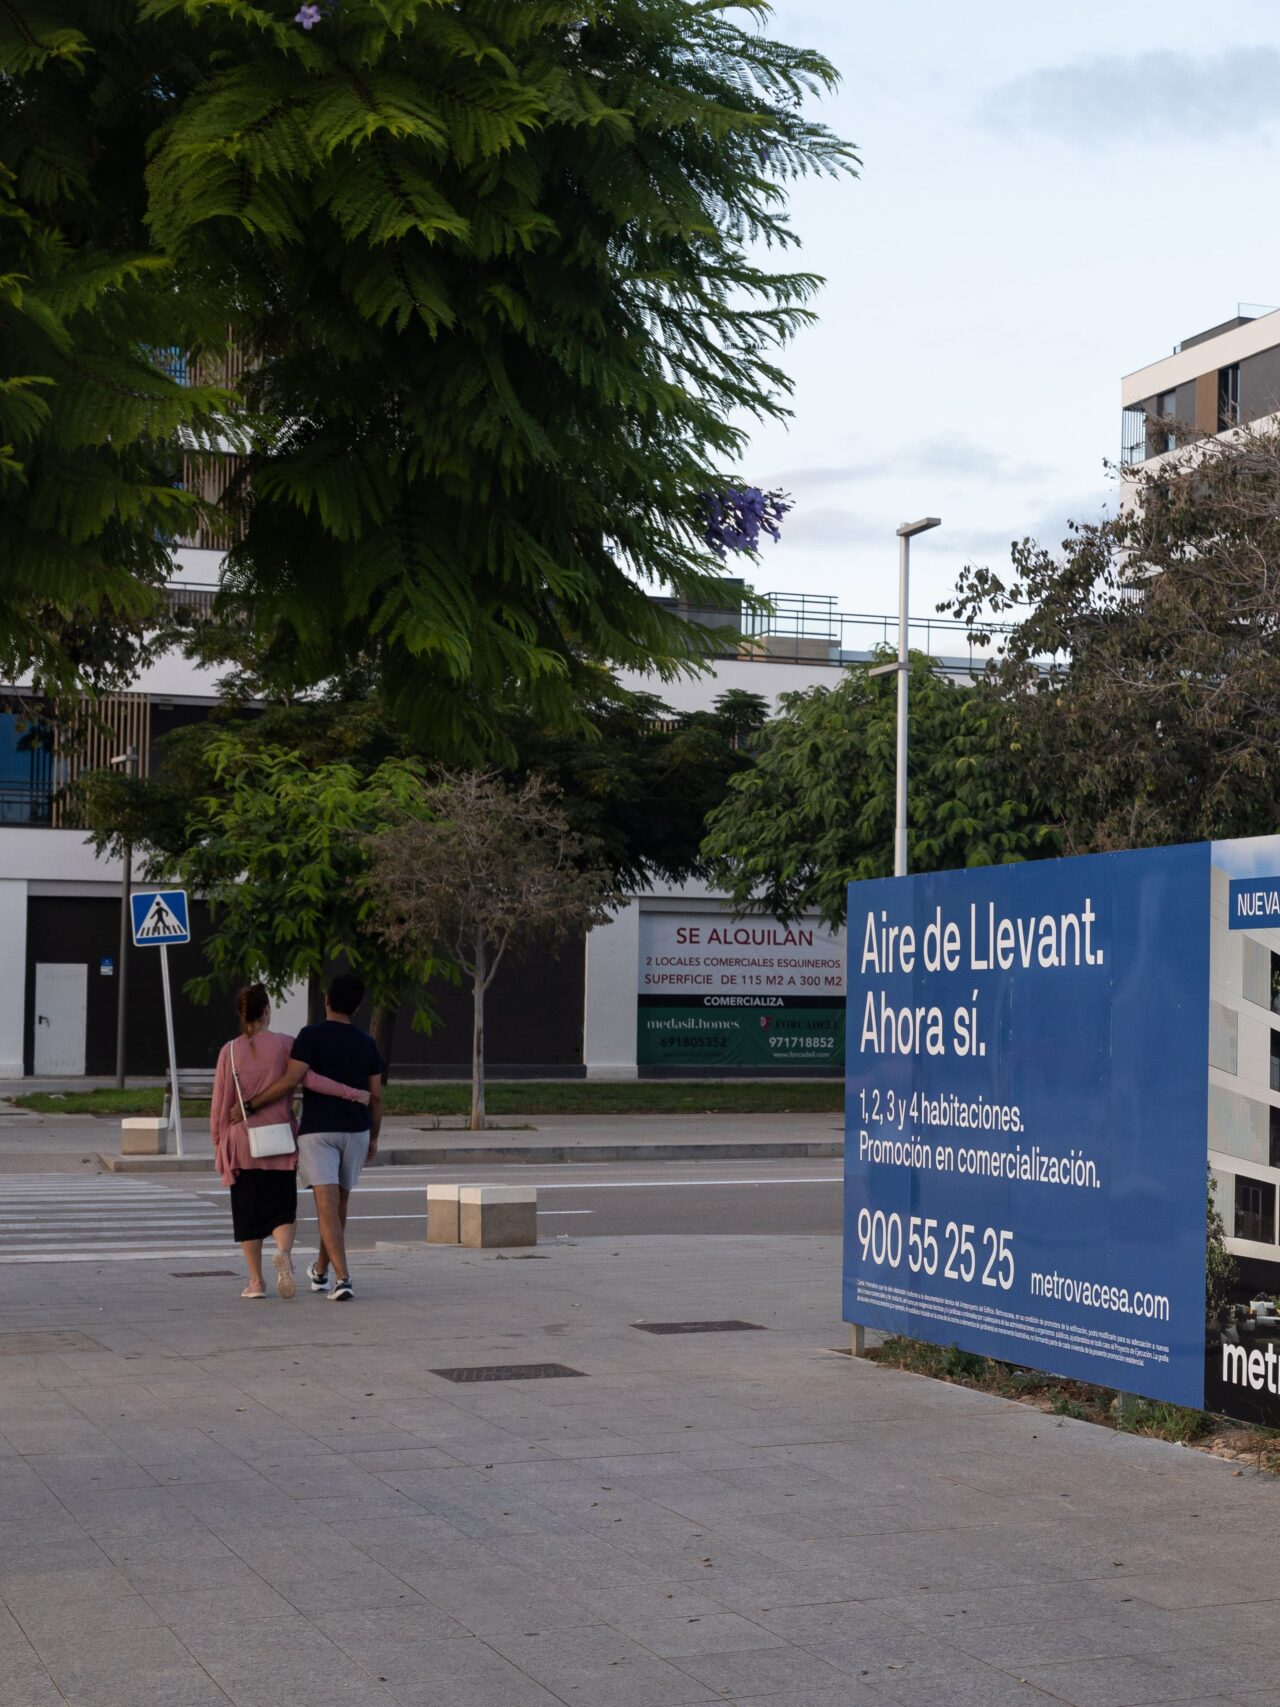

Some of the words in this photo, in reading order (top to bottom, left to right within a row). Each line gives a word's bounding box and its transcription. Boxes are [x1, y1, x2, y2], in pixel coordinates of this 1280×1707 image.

[1237, 890, 1280, 916] NUEVA
[676, 927, 700, 945] SE
[707, 928, 813, 946] ALQUILAN
[860, 910, 916, 974] Aire
[923, 905, 961, 973] de
[970, 898, 1104, 970] Llevant.
[645, 956, 653, 967] 2
[655, 956, 701, 967] LOCALES
[703, 957, 775, 968] COMERCIALES
[777, 958, 841, 969] ESQUINEROS
[644, 974, 713, 985] SUPERFICIE
[720, 974, 737, 985] DE
[741, 975, 762, 985] 115
[766, 975, 784, 986] M2
[787, 975, 796, 986] A
[800, 975, 821, 986] 300
[824, 976, 842, 986] M2
[703, 996, 785, 1007] COMERCIALIZA
[647, 1017, 740, 1030] medasil.homes
[860, 990, 945, 1056] Ahora
[953, 988, 986, 1057] sí.
[769, 1037, 835, 1048] 971718852
[859, 1088, 869, 1124] 1,
[871, 1088, 883, 1125] 2,
[886, 1089, 895, 1122] 3
[897, 1098, 907, 1131] y
[909, 1091, 919, 1124] 4
[921, 1092, 1025, 1133] habitaciones.
[859, 1130, 932, 1169] Promoción
[935, 1146, 954, 1171] en
[957, 1144, 1101, 1188] comercialización.
[857, 1207, 901, 1268] 900
[908, 1216, 938, 1276] 55
[944, 1221, 976, 1283] 25
[981, 1227, 1015, 1290] 25
[1030, 1270, 1170, 1321] metrovacesa.com
